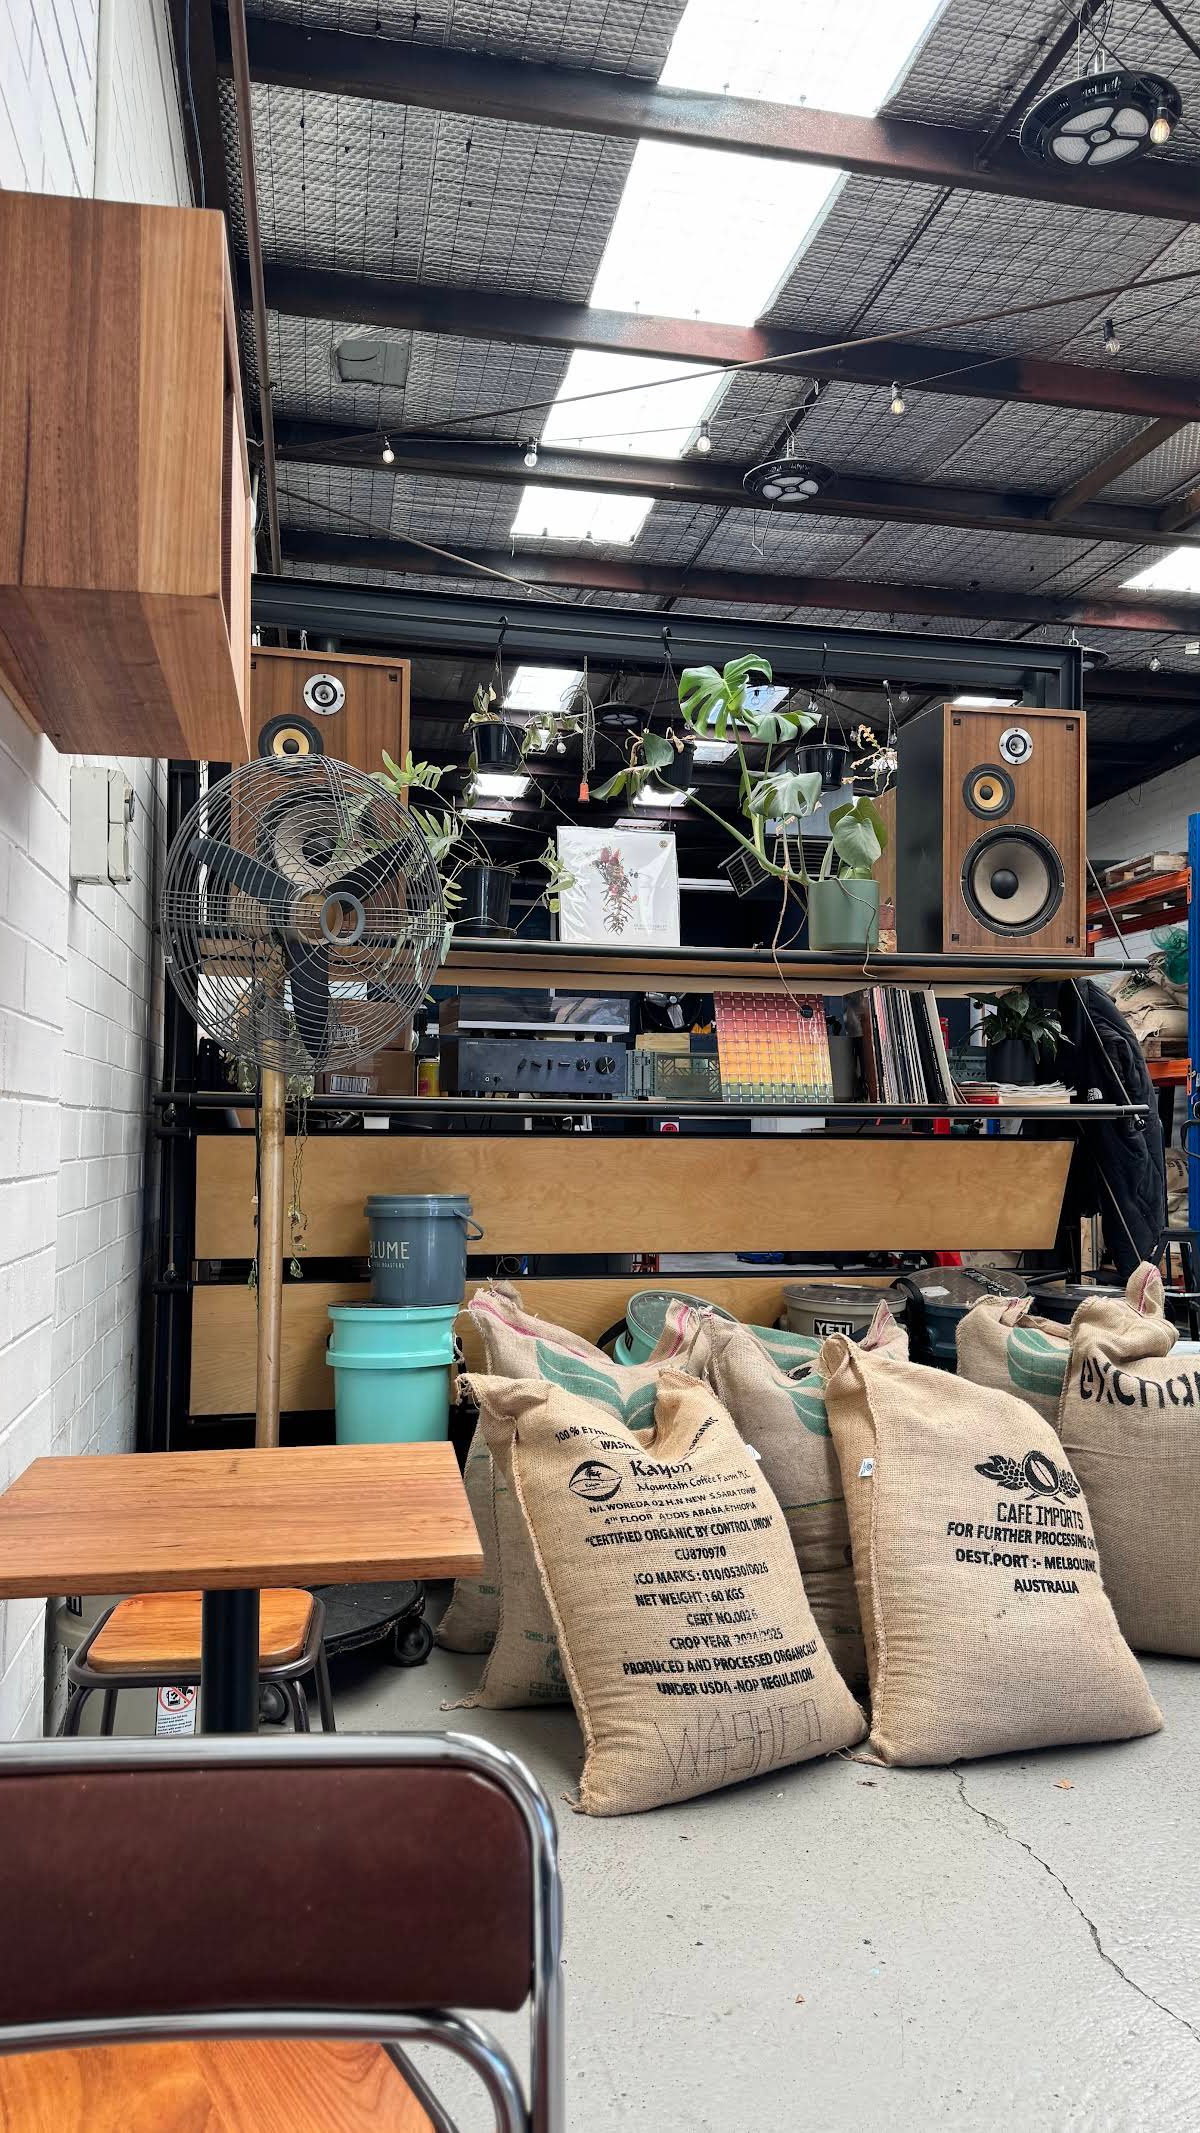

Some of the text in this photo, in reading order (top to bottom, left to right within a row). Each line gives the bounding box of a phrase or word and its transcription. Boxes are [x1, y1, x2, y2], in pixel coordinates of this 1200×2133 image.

[816, 1321, 850, 1336] YETI
[555, 1429, 570, 1444] 100
[600, 1440, 635, 1450] WASH
[637, 1480, 689, 1492] Mountain
[690, 1476, 716, 1487] Coffee
[716, 1472, 738, 1483] Farm
[607, 1500, 650, 1511] WOREDA
[686, 1495, 707, 1503] NEW
[620, 1513, 653, 1523] FLOOR
[659, 1510, 690, 1520] ADDIS
[997, 1502, 1084, 1530] CAFE IMPORTS
[644, 1526, 694, 1541] ORGANIC
[695, 1525, 708, 1537] BY
[710, 1519, 751, 1535] CONTROL
[947, 1521, 973, 1538] FOR
[977, 1524, 1033, 1544] FURTHER
[1035, 1530, 1087, 1549] PROCESSING
[655, 1569, 695, 1584] MARKS
[1014, 1578, 1080, 1594] AUSTRALIA
[635, 1593, 657, 1607] NET
[657, 1591, 702, 1606] WEIGHT
[711, 1590, 724, 1602] 60
[726, 1587, 745, 1601] KGS
[686, 1612, 713, 1627] CERT
[669, 1637, 700, 1651] CROP
[700, 1634, 734, 1648] YEAR
[623, 1640, 818, 1676] PRODUCED AND PROCESSED ORGANICALLY
[656, 1681, 700, 1696] UNDER
[700, 1679, 732, 1695] USDA
[653, 1698, 823, 1791] WASHED
